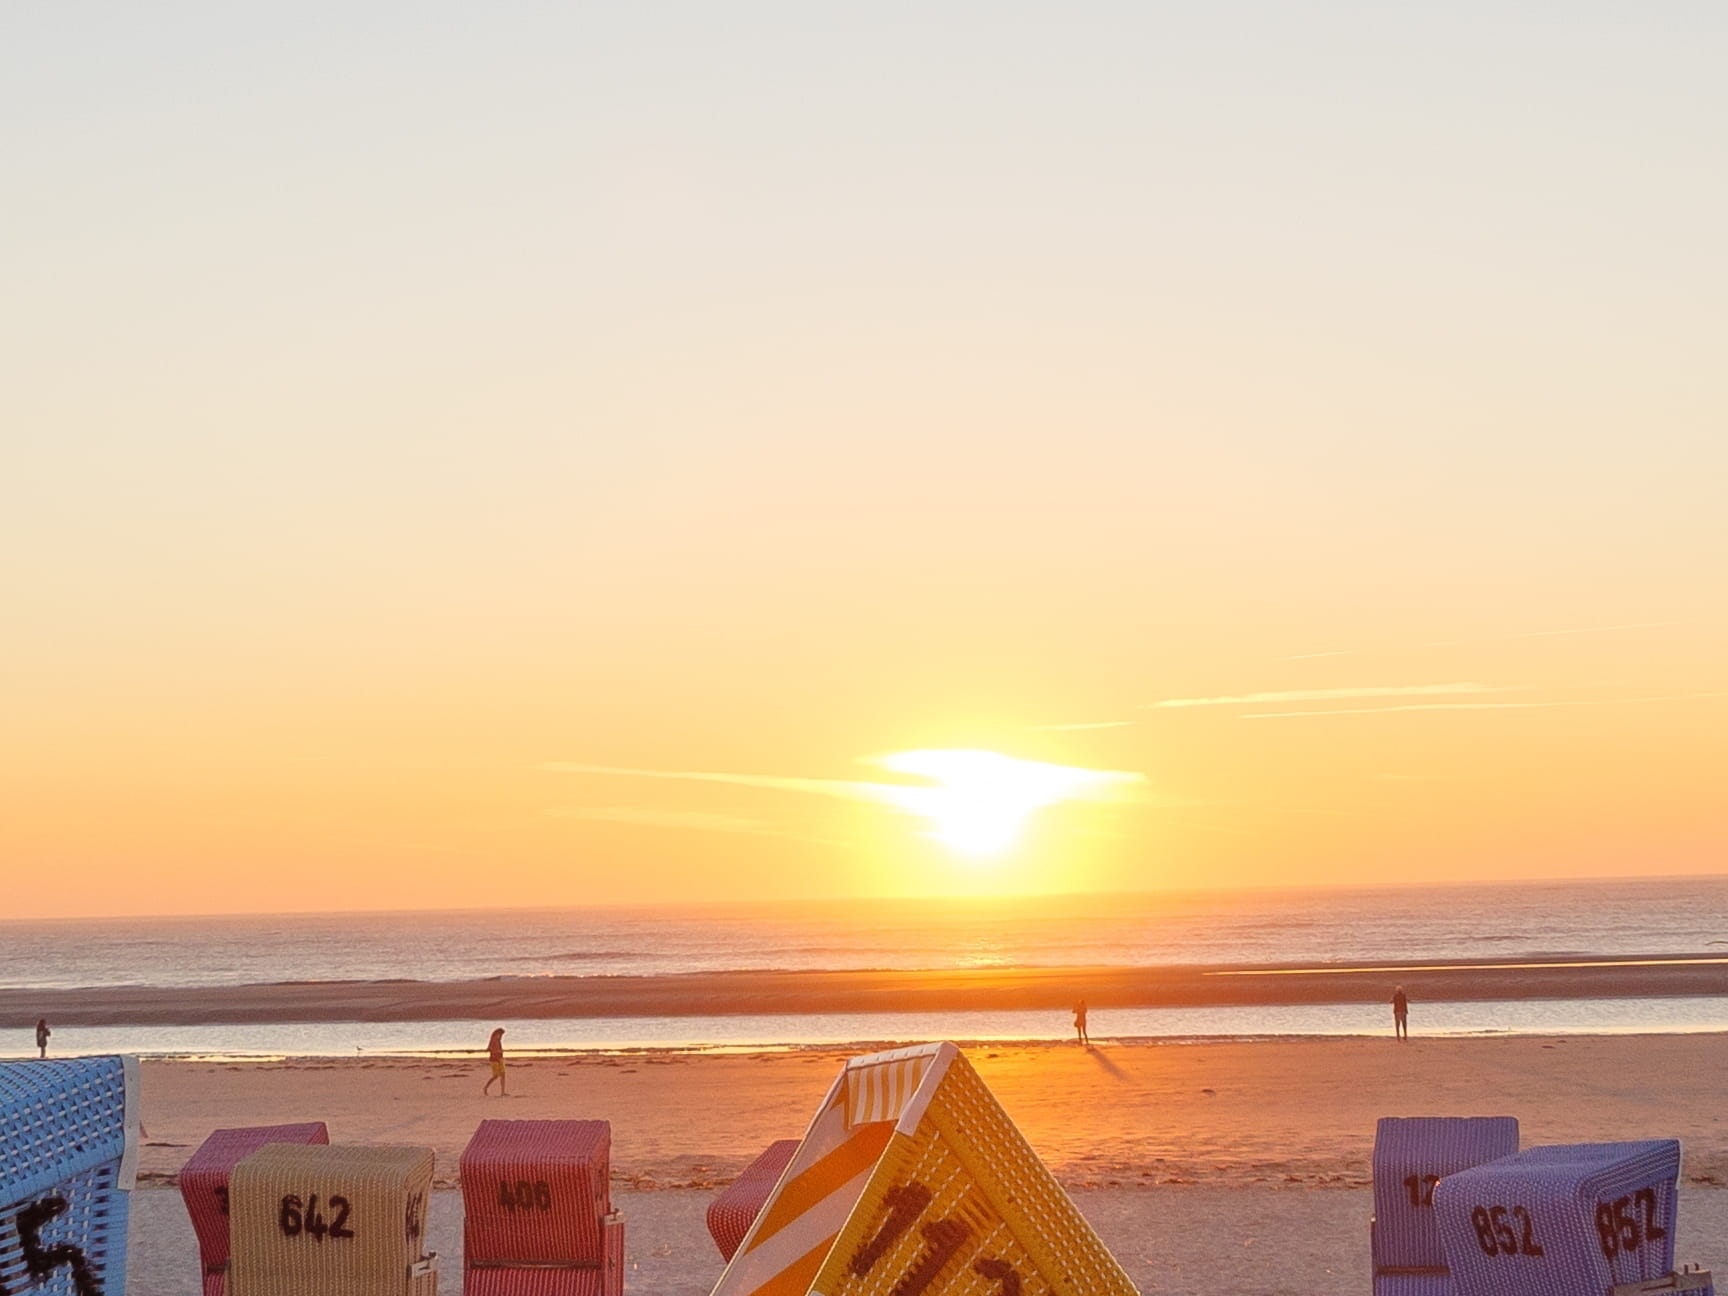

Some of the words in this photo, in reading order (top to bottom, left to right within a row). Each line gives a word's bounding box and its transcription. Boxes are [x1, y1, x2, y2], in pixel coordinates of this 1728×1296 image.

[279, 1194, 354, 1242] 642
[1472, 1205, 1545, 1257] 852
[1596, 1188, 1665, 1260] 852
